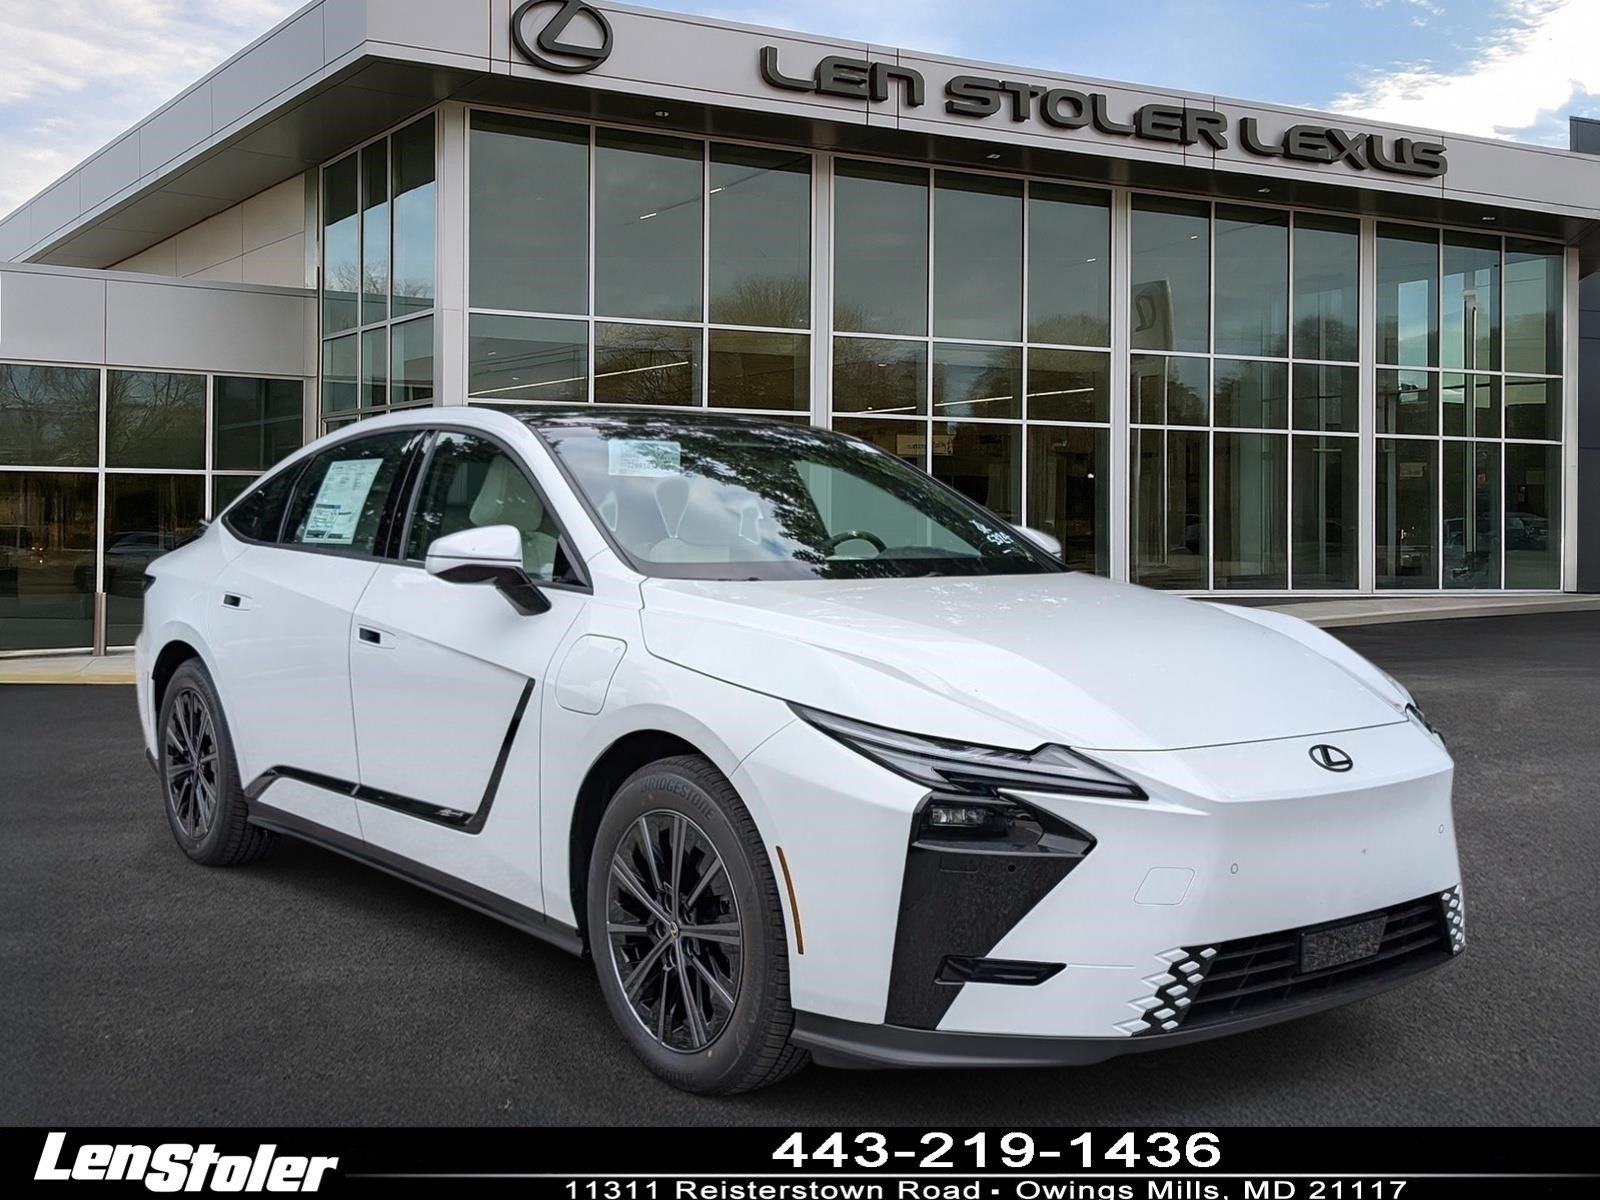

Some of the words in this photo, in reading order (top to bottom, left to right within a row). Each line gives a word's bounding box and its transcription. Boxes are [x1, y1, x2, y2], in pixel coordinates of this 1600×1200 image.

[760, 46, 926, 107] LEN
[943, 72, 1228, 150] STOLER
[1239, 116, 1448, 178] LEXUS
[640, 776, 716, 820] BRIDGESTONE
